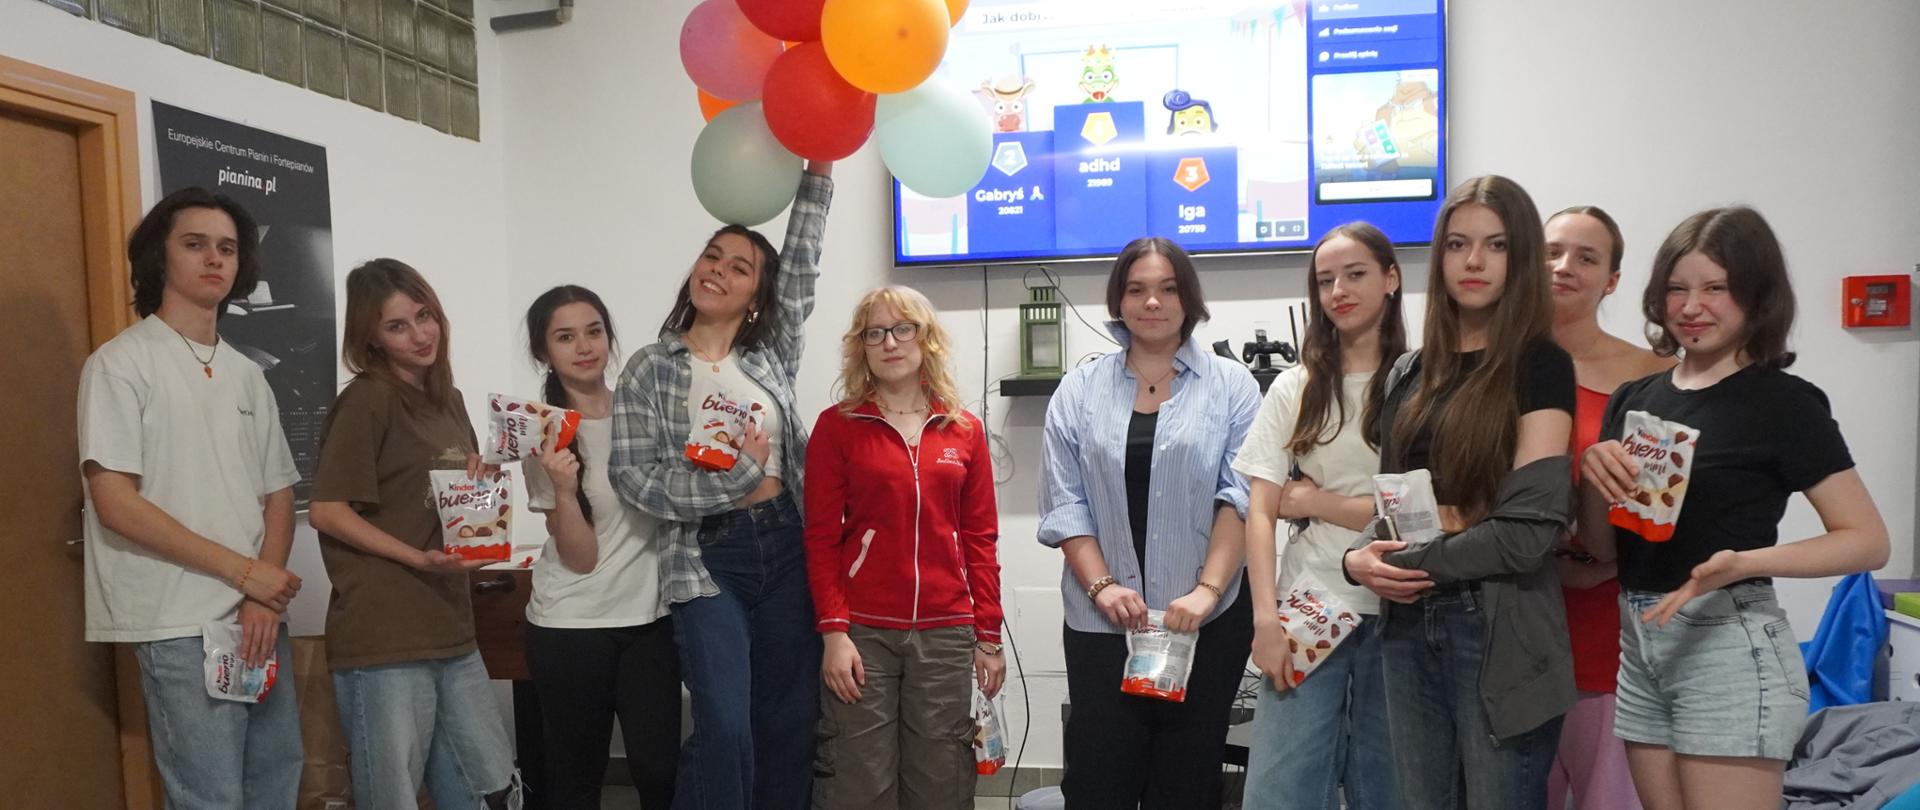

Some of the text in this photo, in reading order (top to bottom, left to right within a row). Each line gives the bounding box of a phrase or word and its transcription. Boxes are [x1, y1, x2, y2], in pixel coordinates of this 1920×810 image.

[982, 12, 1005, 24] Jak
[168, 128, 314, 173] Europejskie Centrum Pianin i Fortepianów
[1003, 150, 1016, 165] 2
[1079, 158, 1120, 173] adhd
[1184, 165, 1198, 182] 3
[975, 187, 1024, 203] Gabryś
[1178, 204, 1206, 221] Iga
[702, 394, 748, 419] bueno
[448, 482, 475, 491] Kinder
[218, 654, 231, 694] bueno
